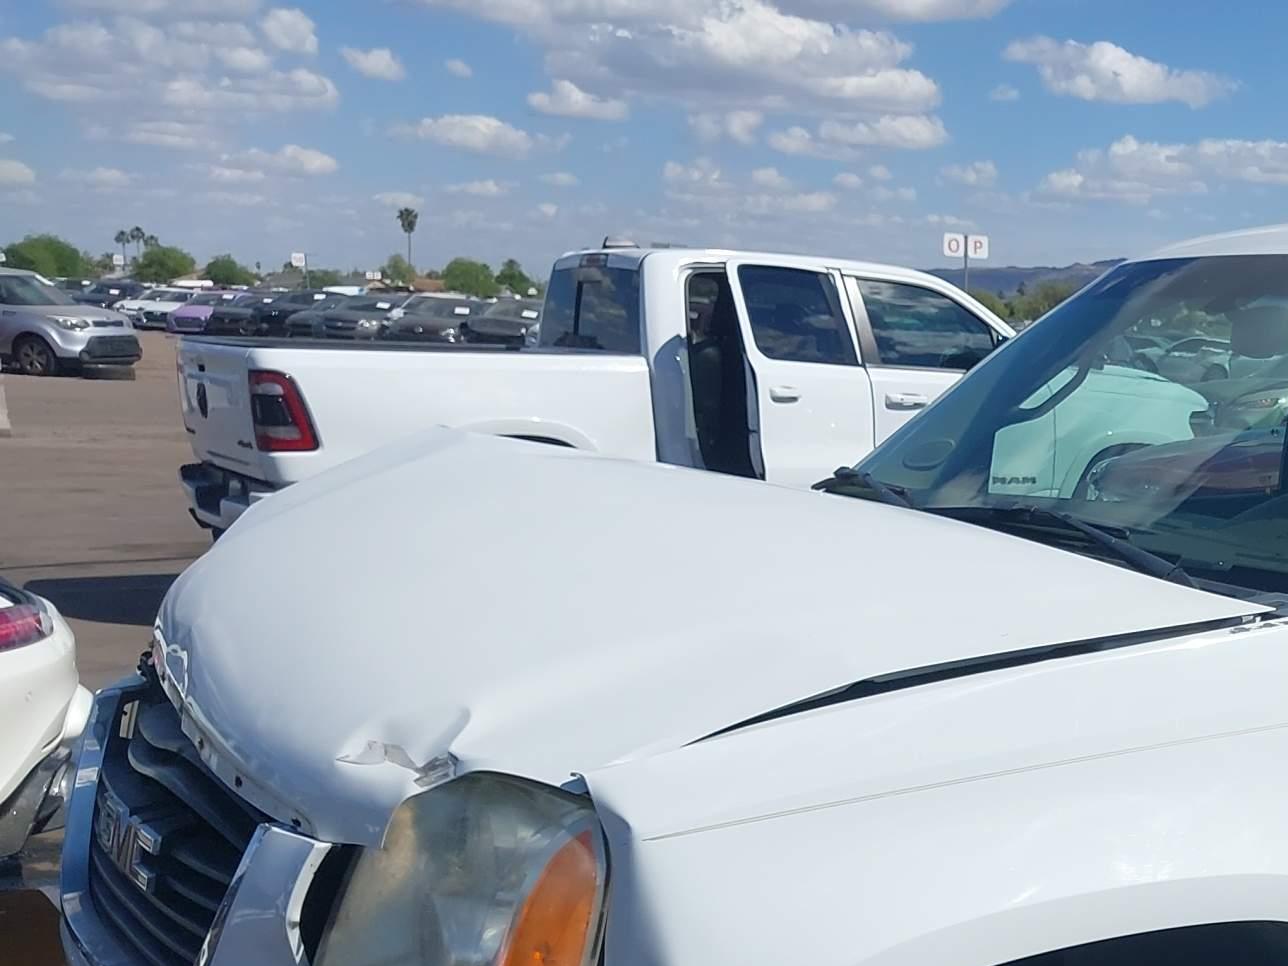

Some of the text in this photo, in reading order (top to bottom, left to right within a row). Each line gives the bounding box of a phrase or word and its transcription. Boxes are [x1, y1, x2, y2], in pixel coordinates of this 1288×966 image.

[974, 240, 983, 255] P
[992, 476, 1037, 484] RAM
[98, 792, 163, 893] GMC
